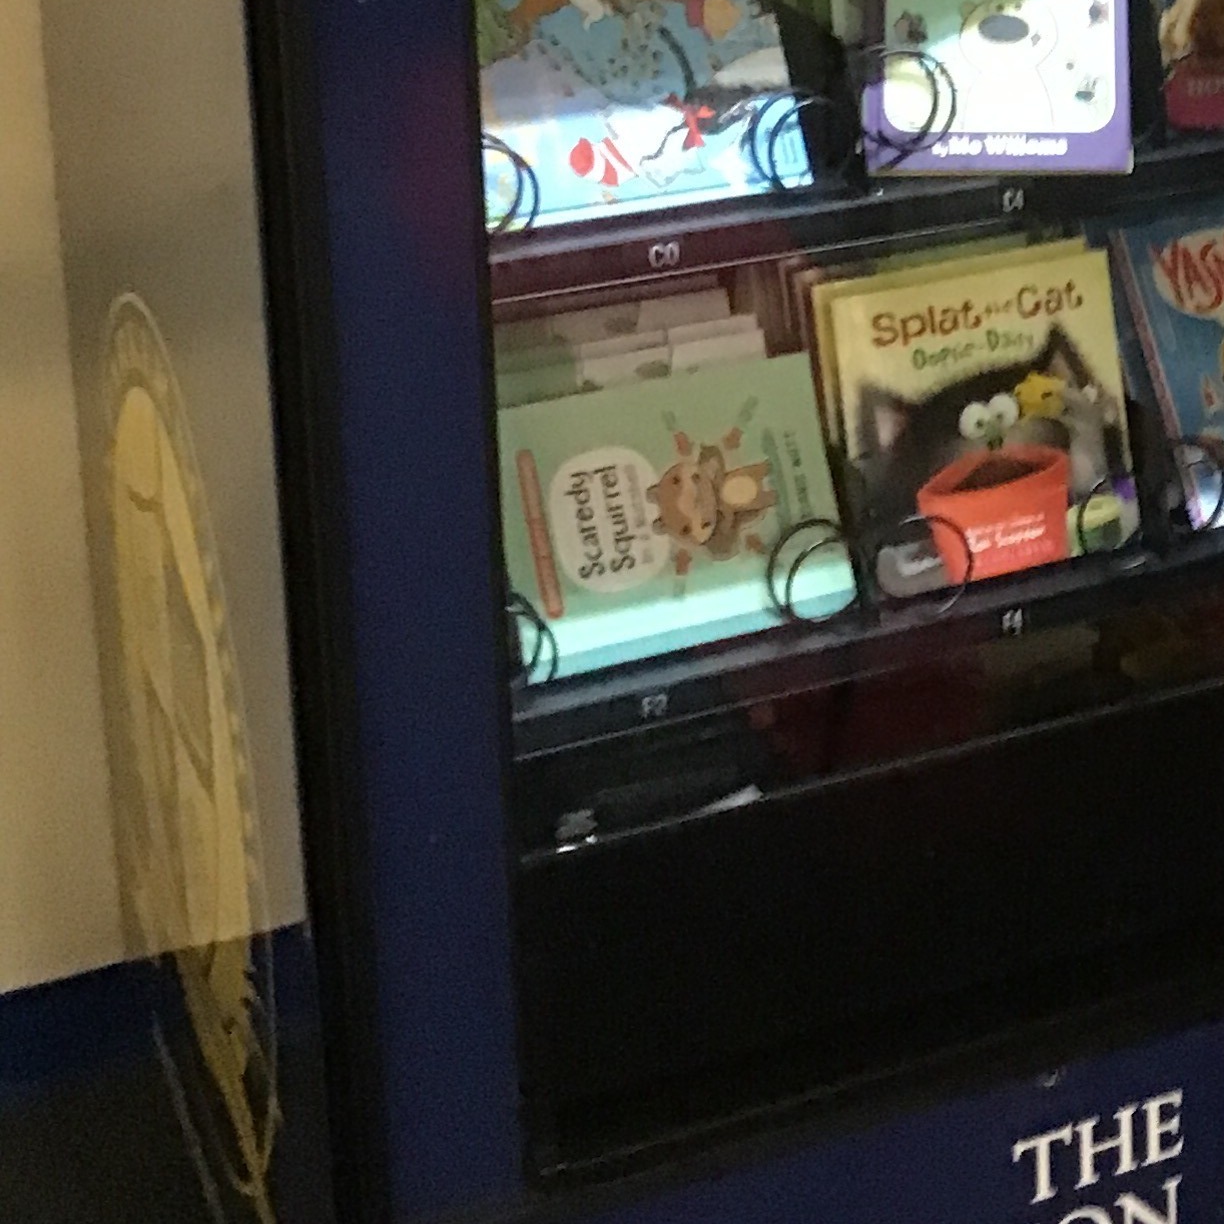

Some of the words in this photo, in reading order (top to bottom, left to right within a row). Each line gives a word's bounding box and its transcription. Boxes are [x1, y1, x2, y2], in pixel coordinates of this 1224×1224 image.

[872, 298, 982, 348] Splat
[1016, 278, 1083, 319] Cat
[565, 471, 606, 579] Scaredy
[594, 464, 637, 572] Squirrel
[1011, 1088, 1185, 1205] THE
